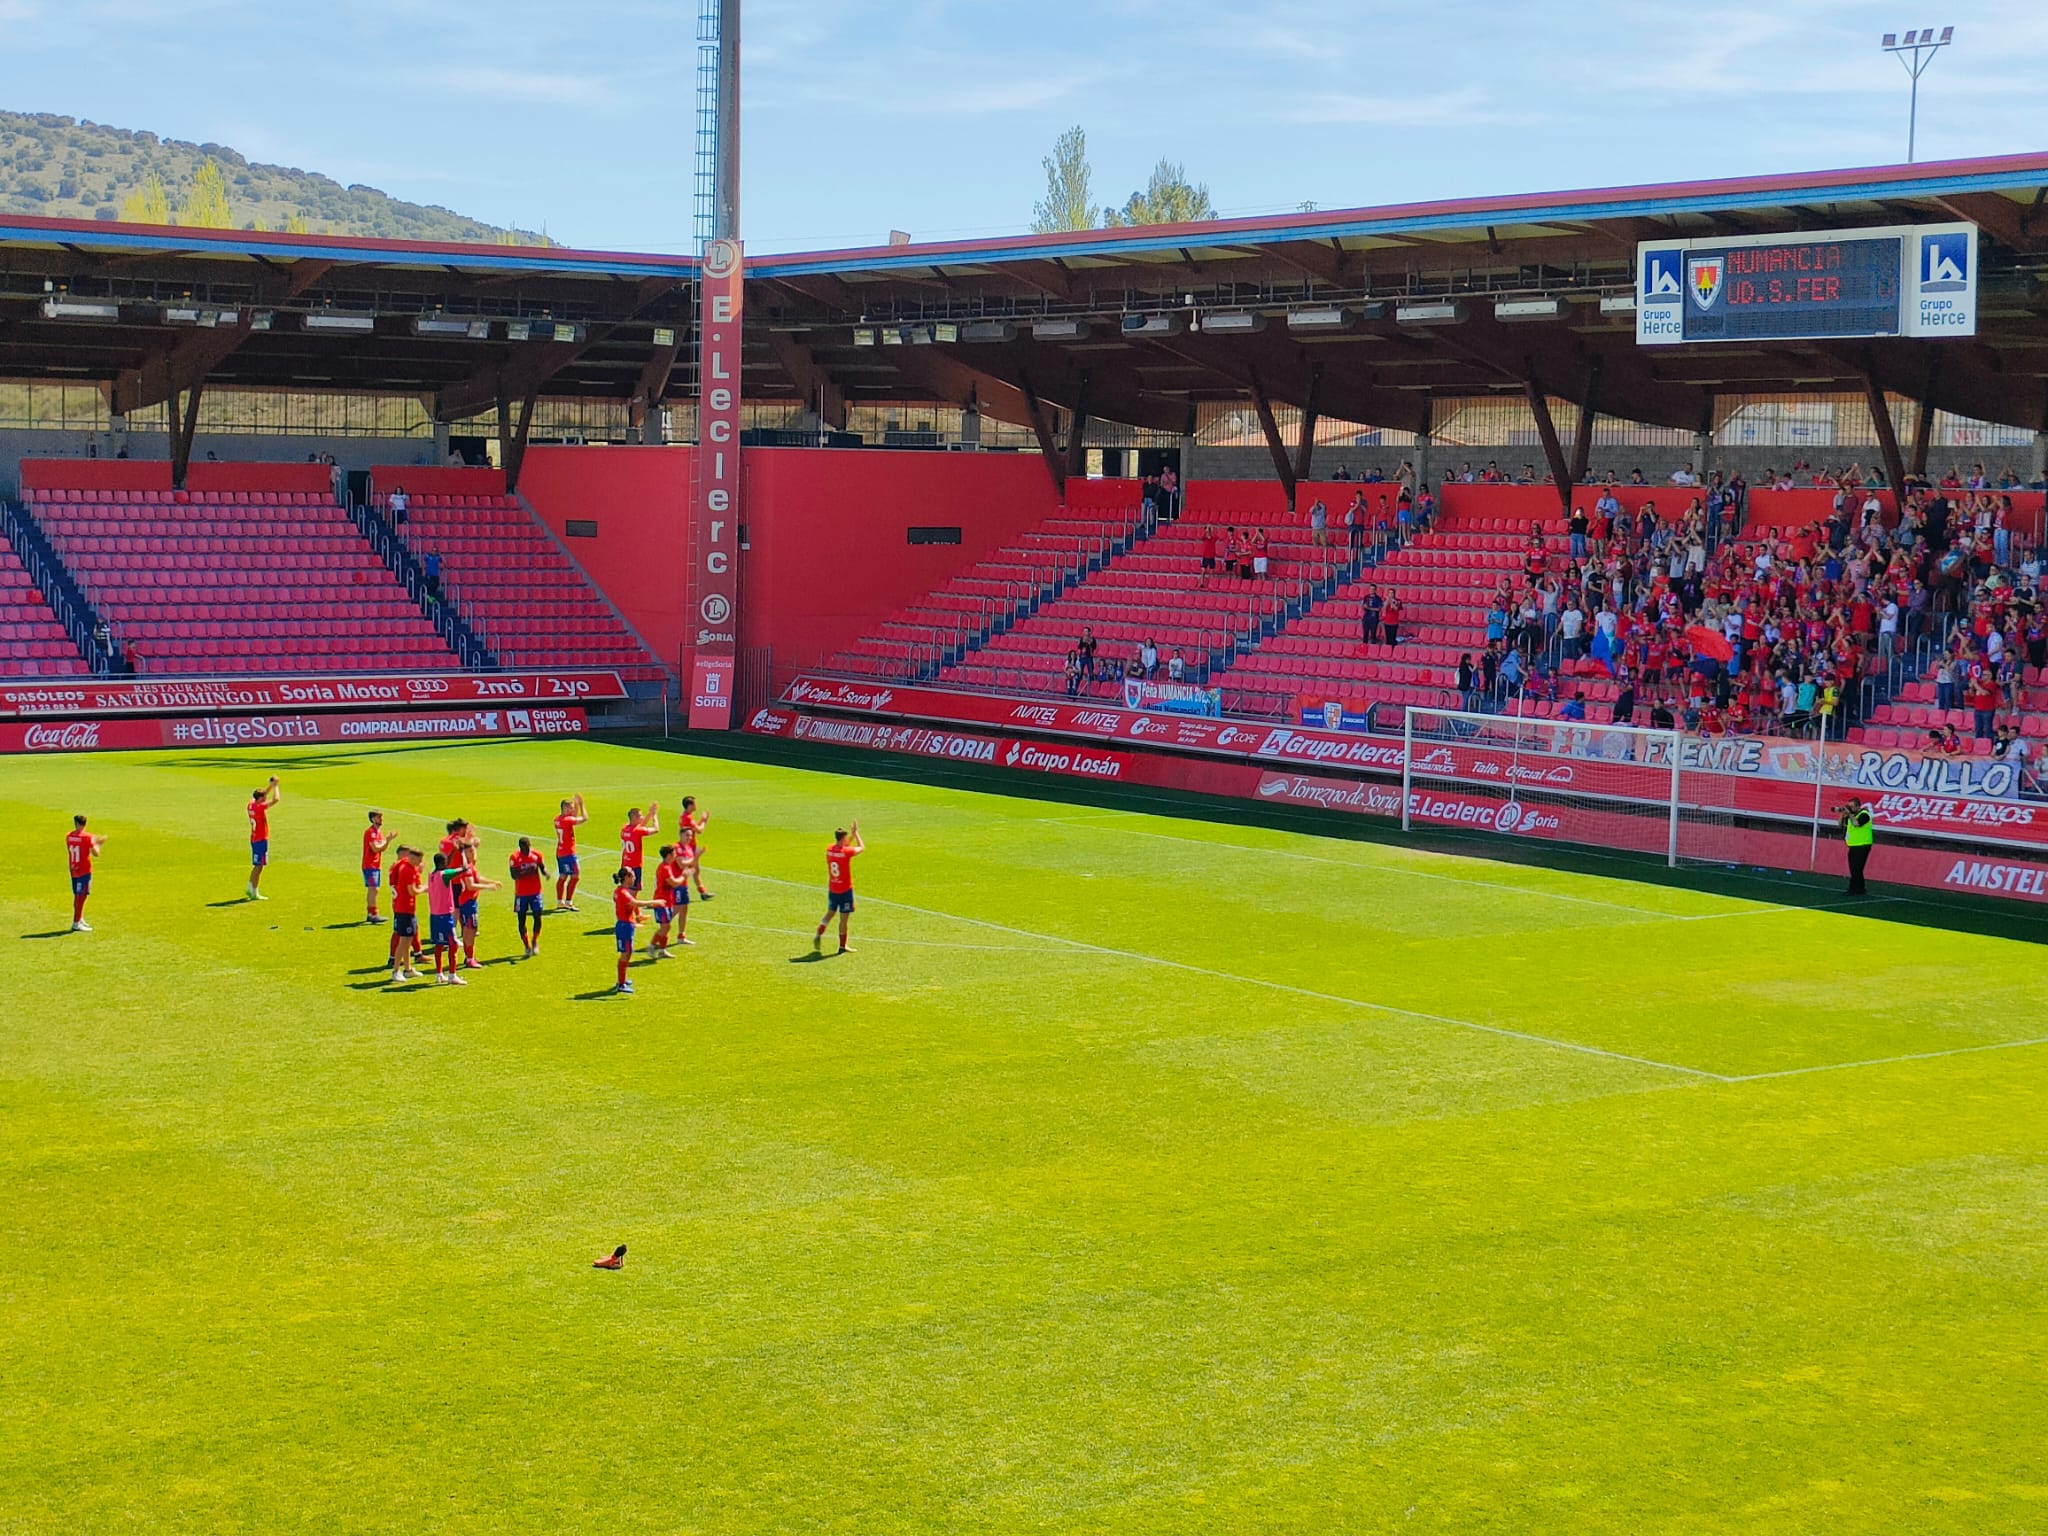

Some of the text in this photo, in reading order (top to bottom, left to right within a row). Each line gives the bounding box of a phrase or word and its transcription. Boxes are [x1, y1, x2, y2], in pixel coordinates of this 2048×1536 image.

[1728, 247, 1841, 274] NUMANCIA
[1921, 300, 1952, 311] Grupo
[1644, 310, 1671, 321] Grupo
[1921, 312, 1966, 326] Herce
[1644, 321, 1681, 334] Herce
[5, 689, 86, 703] GASÓLEOS
[134, 682, 229, 693] RESTAURANTE
[280, 682, 399, 701] Soria Motor
[808, 687, 831, 702] Caja
[843, 692, 871, 705] Soria
[1142, 682, 1157, 698] Peña
[1158, 684, 1193, 702] NUMANCIA
[96, 690, 272, 707] SANTO DOMINGO II
[532, 709, 567, 722] Grupo
[1009, 704, 1059, 721] AVATEL
[1070, 711, 1121, 728] AVATEL
[173, 714, 320, 744] #eligeSoria
[340, 717, 477, 735] COMPRALAENTRADA
[533, 718, 582, 733] Herce
[24, 723, 101, 749] Coca-Cola
[1286, 735, 1405, 765] Grupo Herce
[1644, 734, 1765, 772] FRENTE
[1021, 747, 1121, 777] Grupo Losán
[1857, 751, 2014, 797] ROJILLO
[1288, 777, 1402, 810] Torrezno de Soria
[1875, 794, 2036, 825] MONTE PINOS
[69, 845, 80, 863] 11
[831, 861, 840, 877] 8
[1945, 861, 2045, 895] AMSTEL
